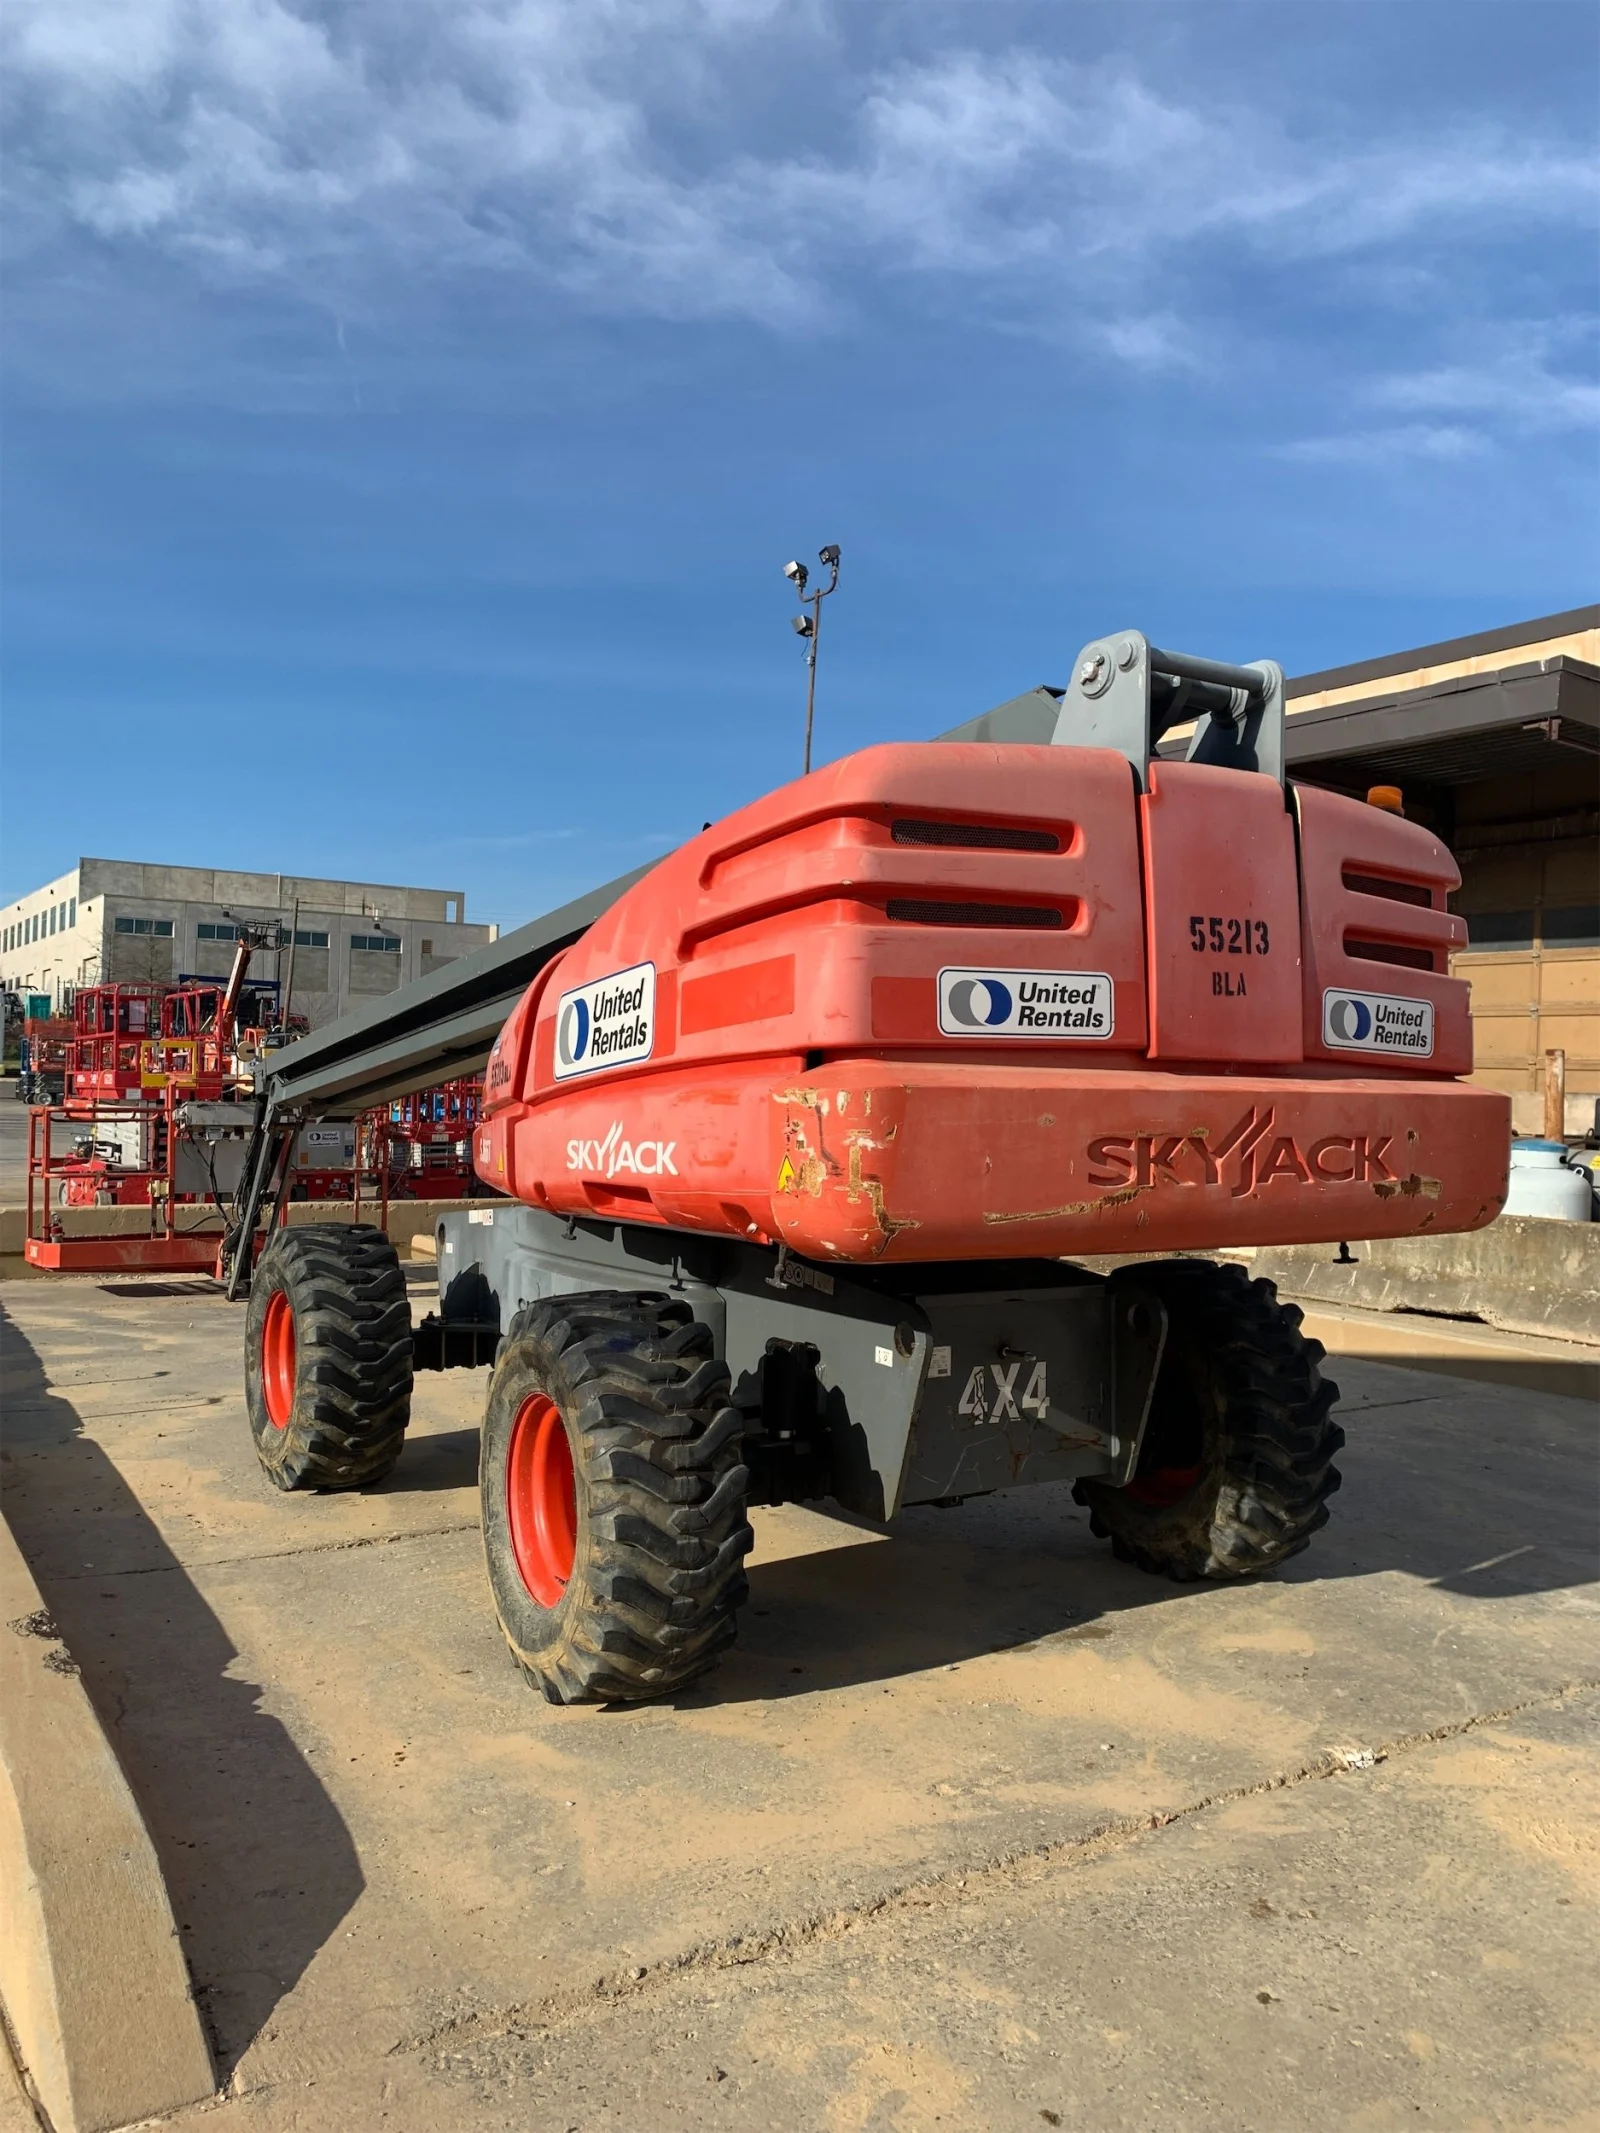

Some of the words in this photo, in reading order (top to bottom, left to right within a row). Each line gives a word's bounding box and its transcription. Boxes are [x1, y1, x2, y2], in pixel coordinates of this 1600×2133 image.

[1190, 916, 1270, 955] 55213
[592, 977, 646, 1023] United
[1018, 981, 1098, 1005] United
[1212, 971, 1247, 996] BLA
[1017, 1005, 1104, 1029] Rentals
[1375, 1004, 1424, 1028] United
[590, 1014, 648, 1058] Rentals
[1373, 1024, 1428, 1048] Rentals
[566, 1119, 680, 1180] SKYJACK
[1086, 1105, 1399, 1200] SKYJACK
[958, 1361, 1051, 1426] 4X4
